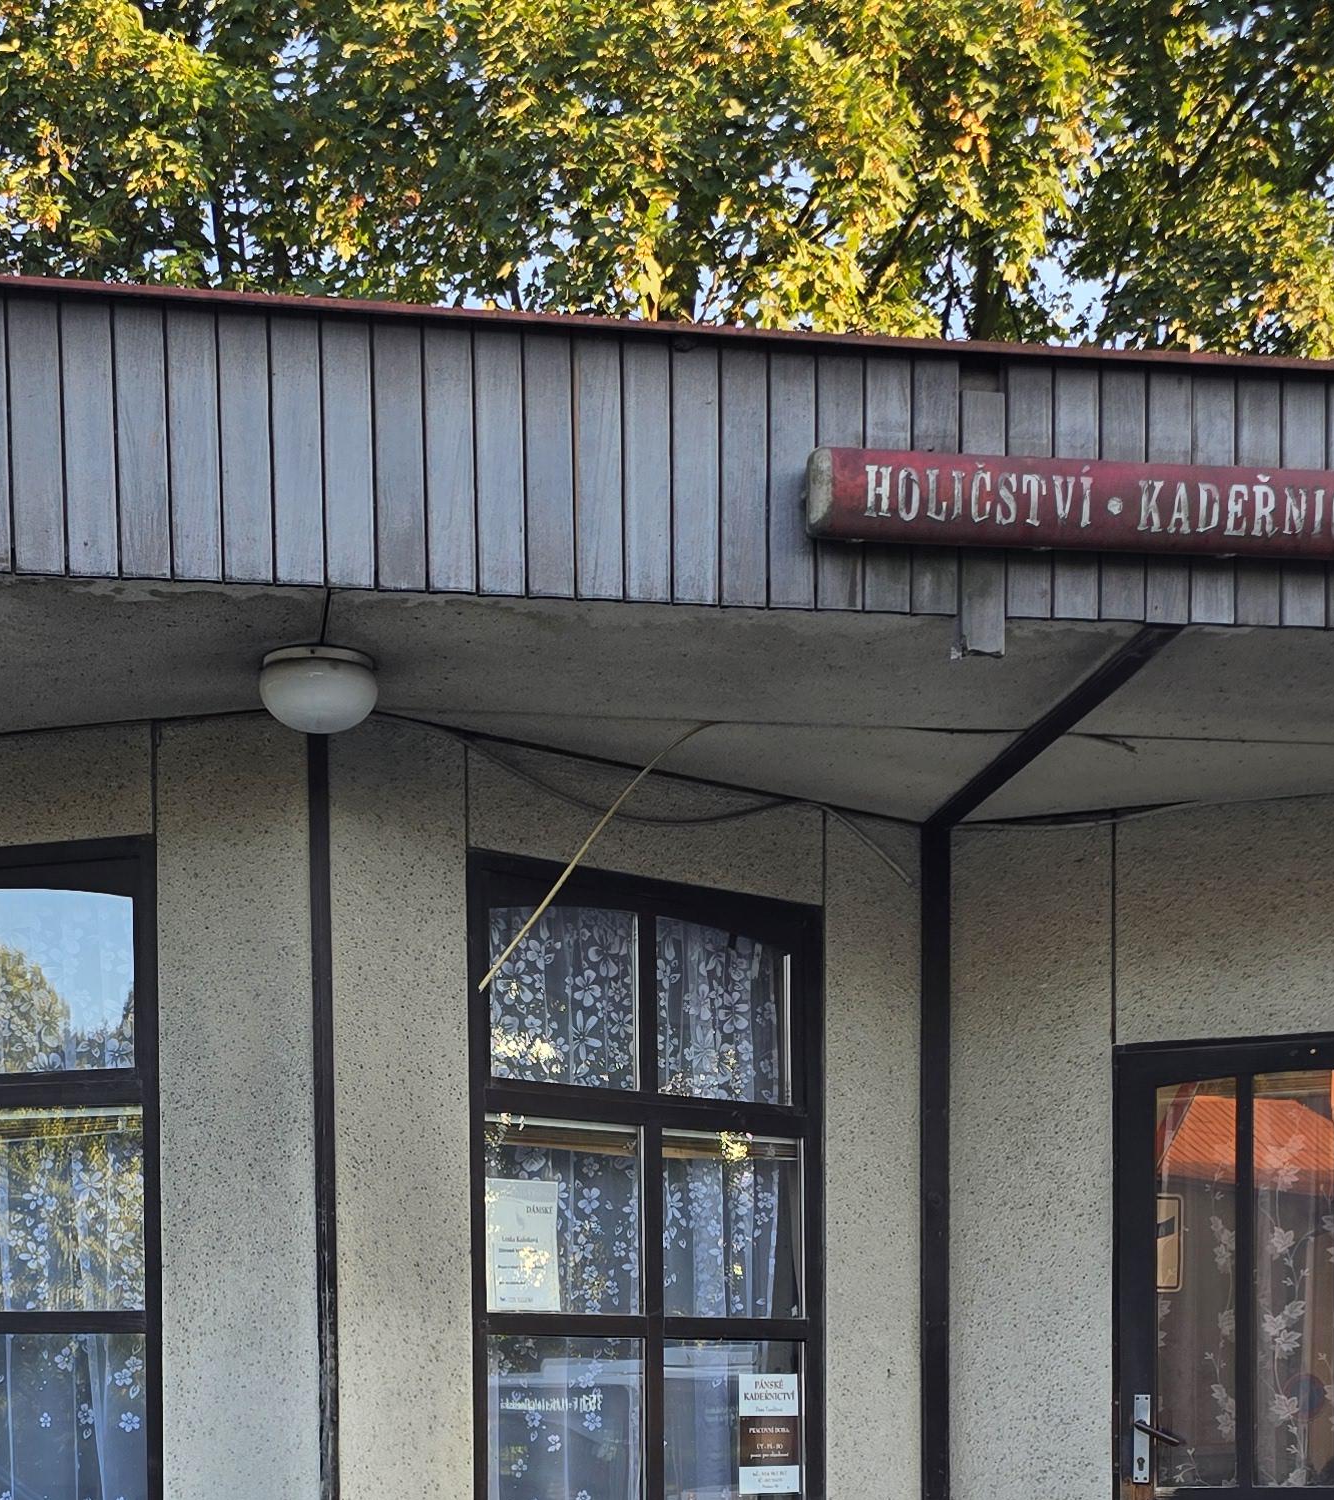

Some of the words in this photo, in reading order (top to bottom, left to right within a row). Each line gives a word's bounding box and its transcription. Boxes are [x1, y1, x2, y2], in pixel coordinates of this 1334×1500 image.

[863, 461, 1095, 529] HOLIČSTVÍ
[754, 1378, 784, 1390] PÁNSKÉ
[743, 1390, 795, 1401] KADEŘNICTVÍ
